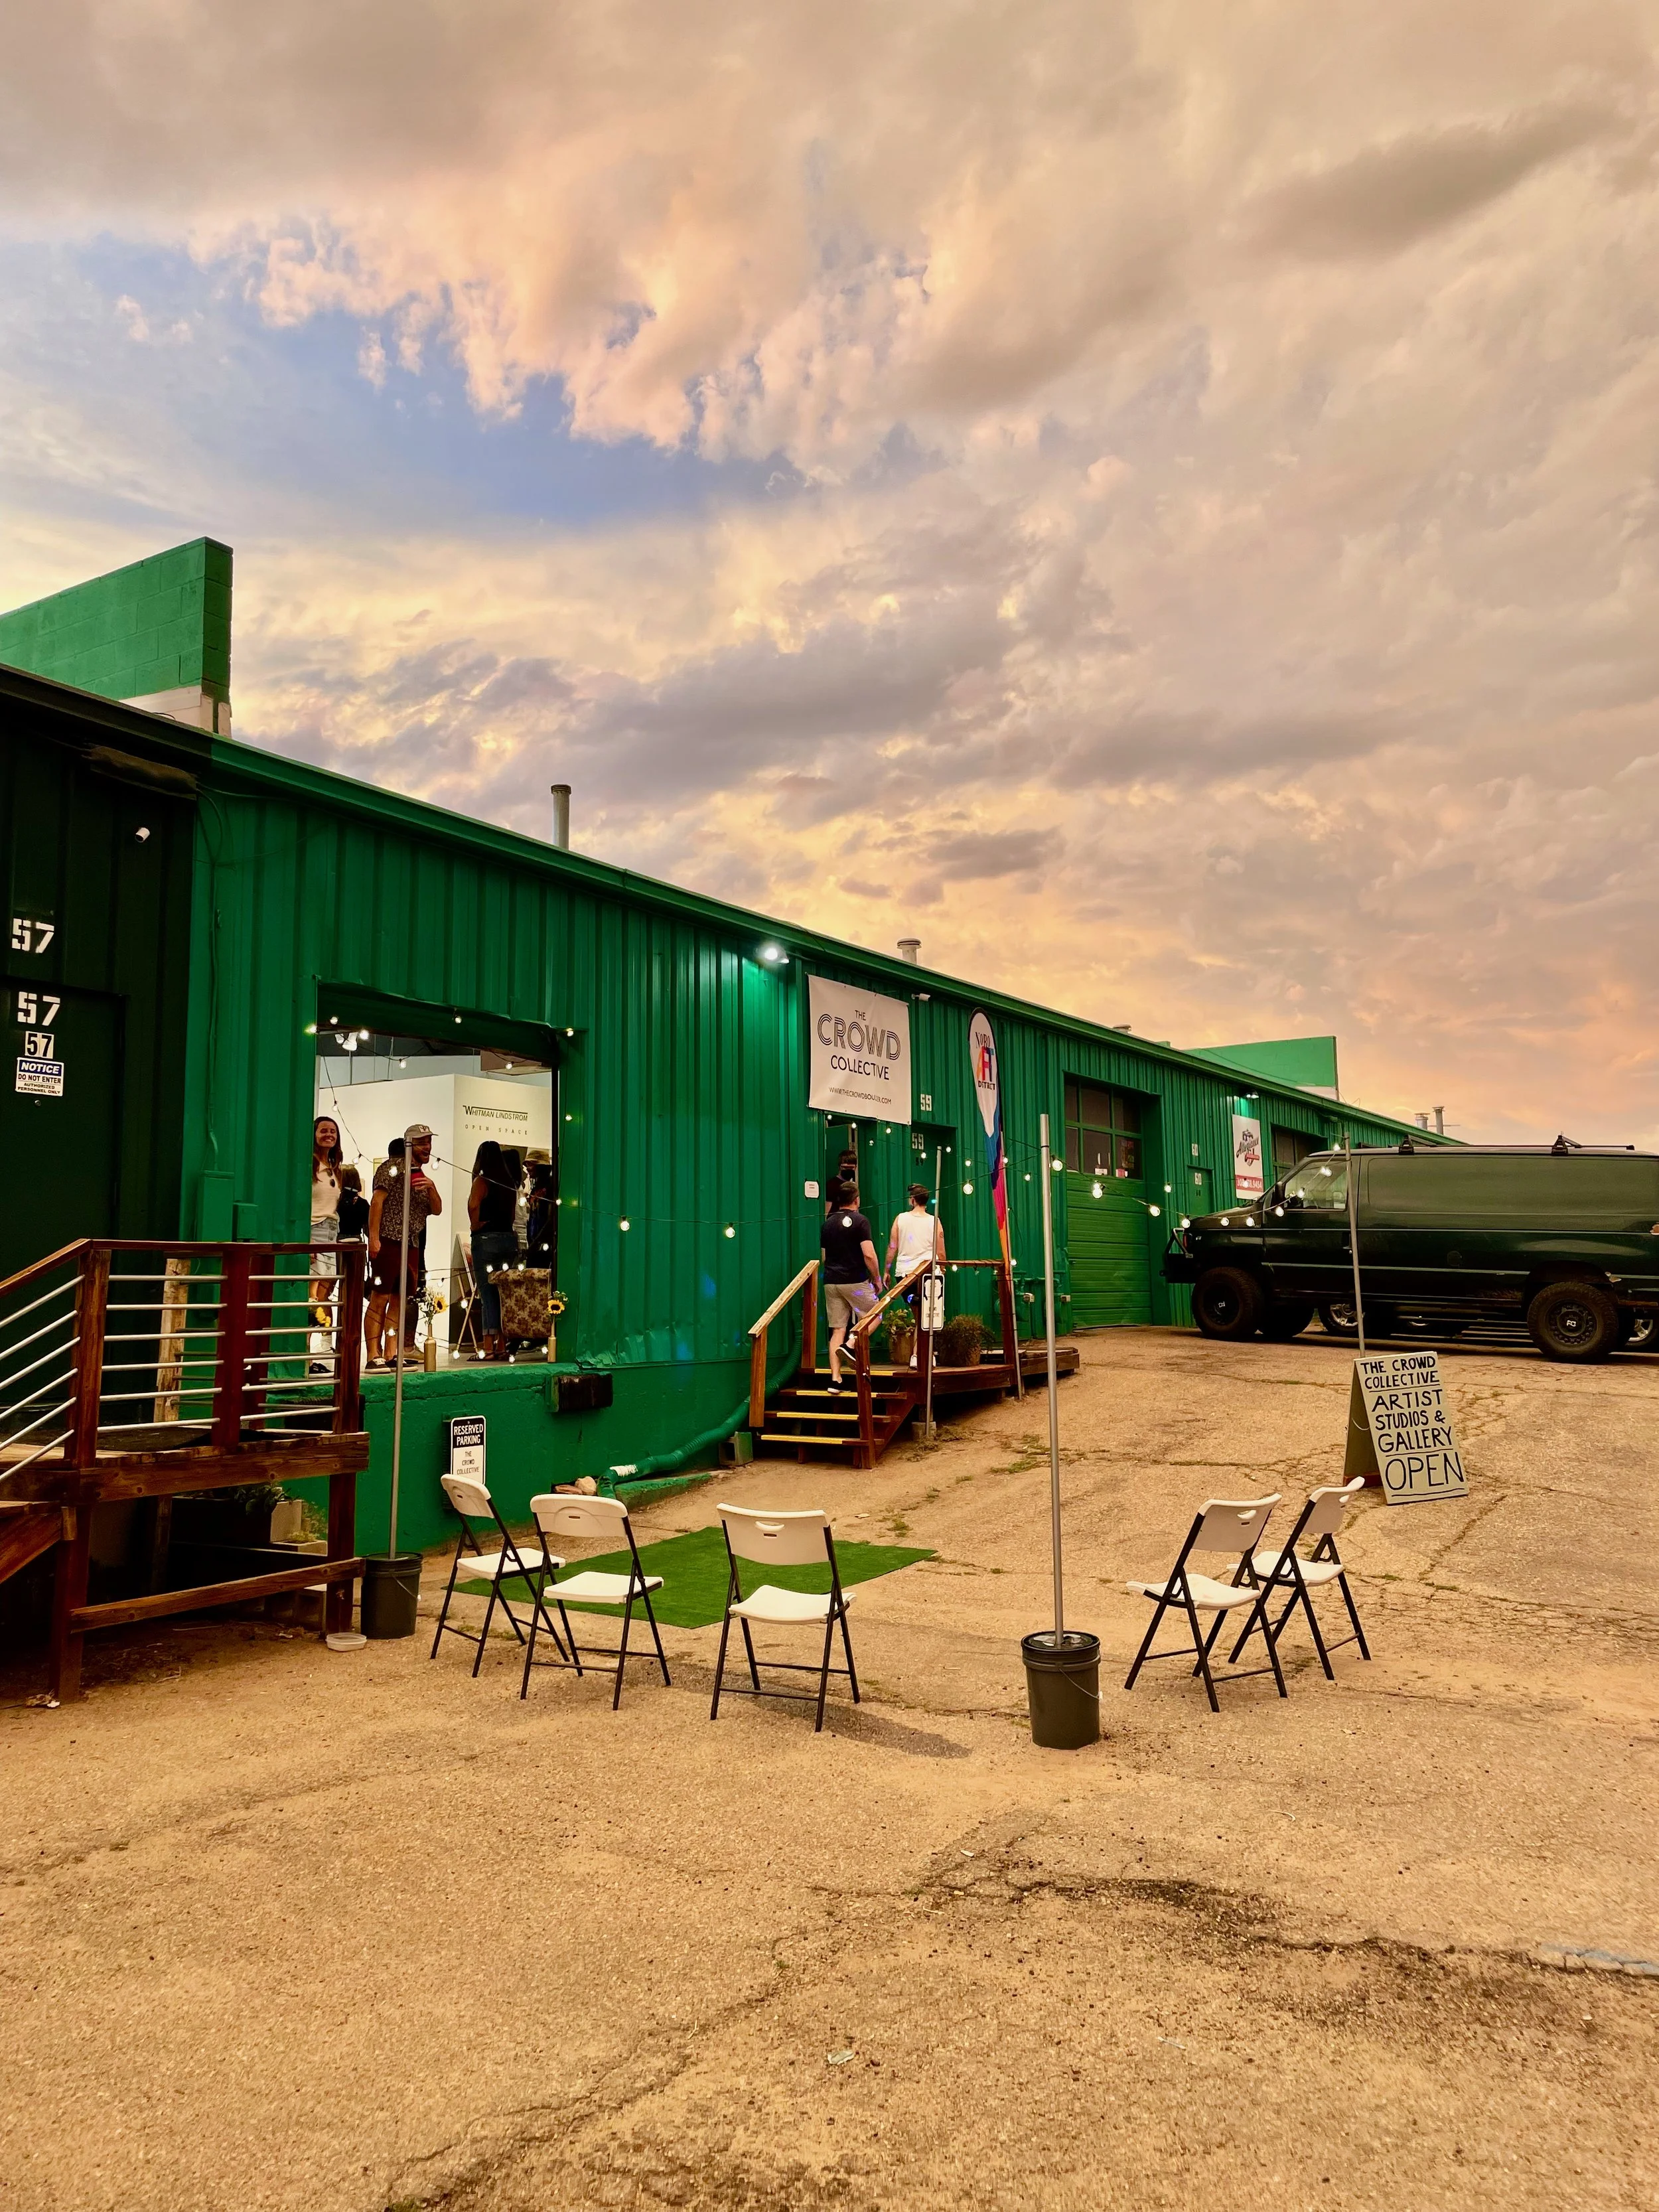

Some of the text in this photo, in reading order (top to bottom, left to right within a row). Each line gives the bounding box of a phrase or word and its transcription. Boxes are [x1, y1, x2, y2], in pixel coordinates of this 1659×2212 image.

[11, 918, 54, 954] 57
[17, 992, 61, 1027] 57
[855, 1009, 866, 1021] THE
[27, 1033, 52, 1057] 57
[817, 1013, 901, 1061] CROWD
[21, 1062, 60, 1074] NOTICE
[830, 1055, 889, 1081] COLLECTIVE
[920, 1094, 932, 1111] 59
[463, 1105, 528, 1122] WHITMAN LINDSTROM
[912, 1133, 924, 1149] 59
[1360, 1356, 1436, 1374] THE CROWD
[1364, 1370, 1440, 1389] COLLECTIVE
[1372, 1388, 1443, 1412] ARTIST
[454, 1424, 483, 1436] RESERVED
[1375, 1410, 1446, 1431] STUDIOS &
[457, 1435, 481, 1446] PARKING
[1378, 1426, 1453, 1453] GALLERY
[1385, 1451, 1465, 1491] OPEN
